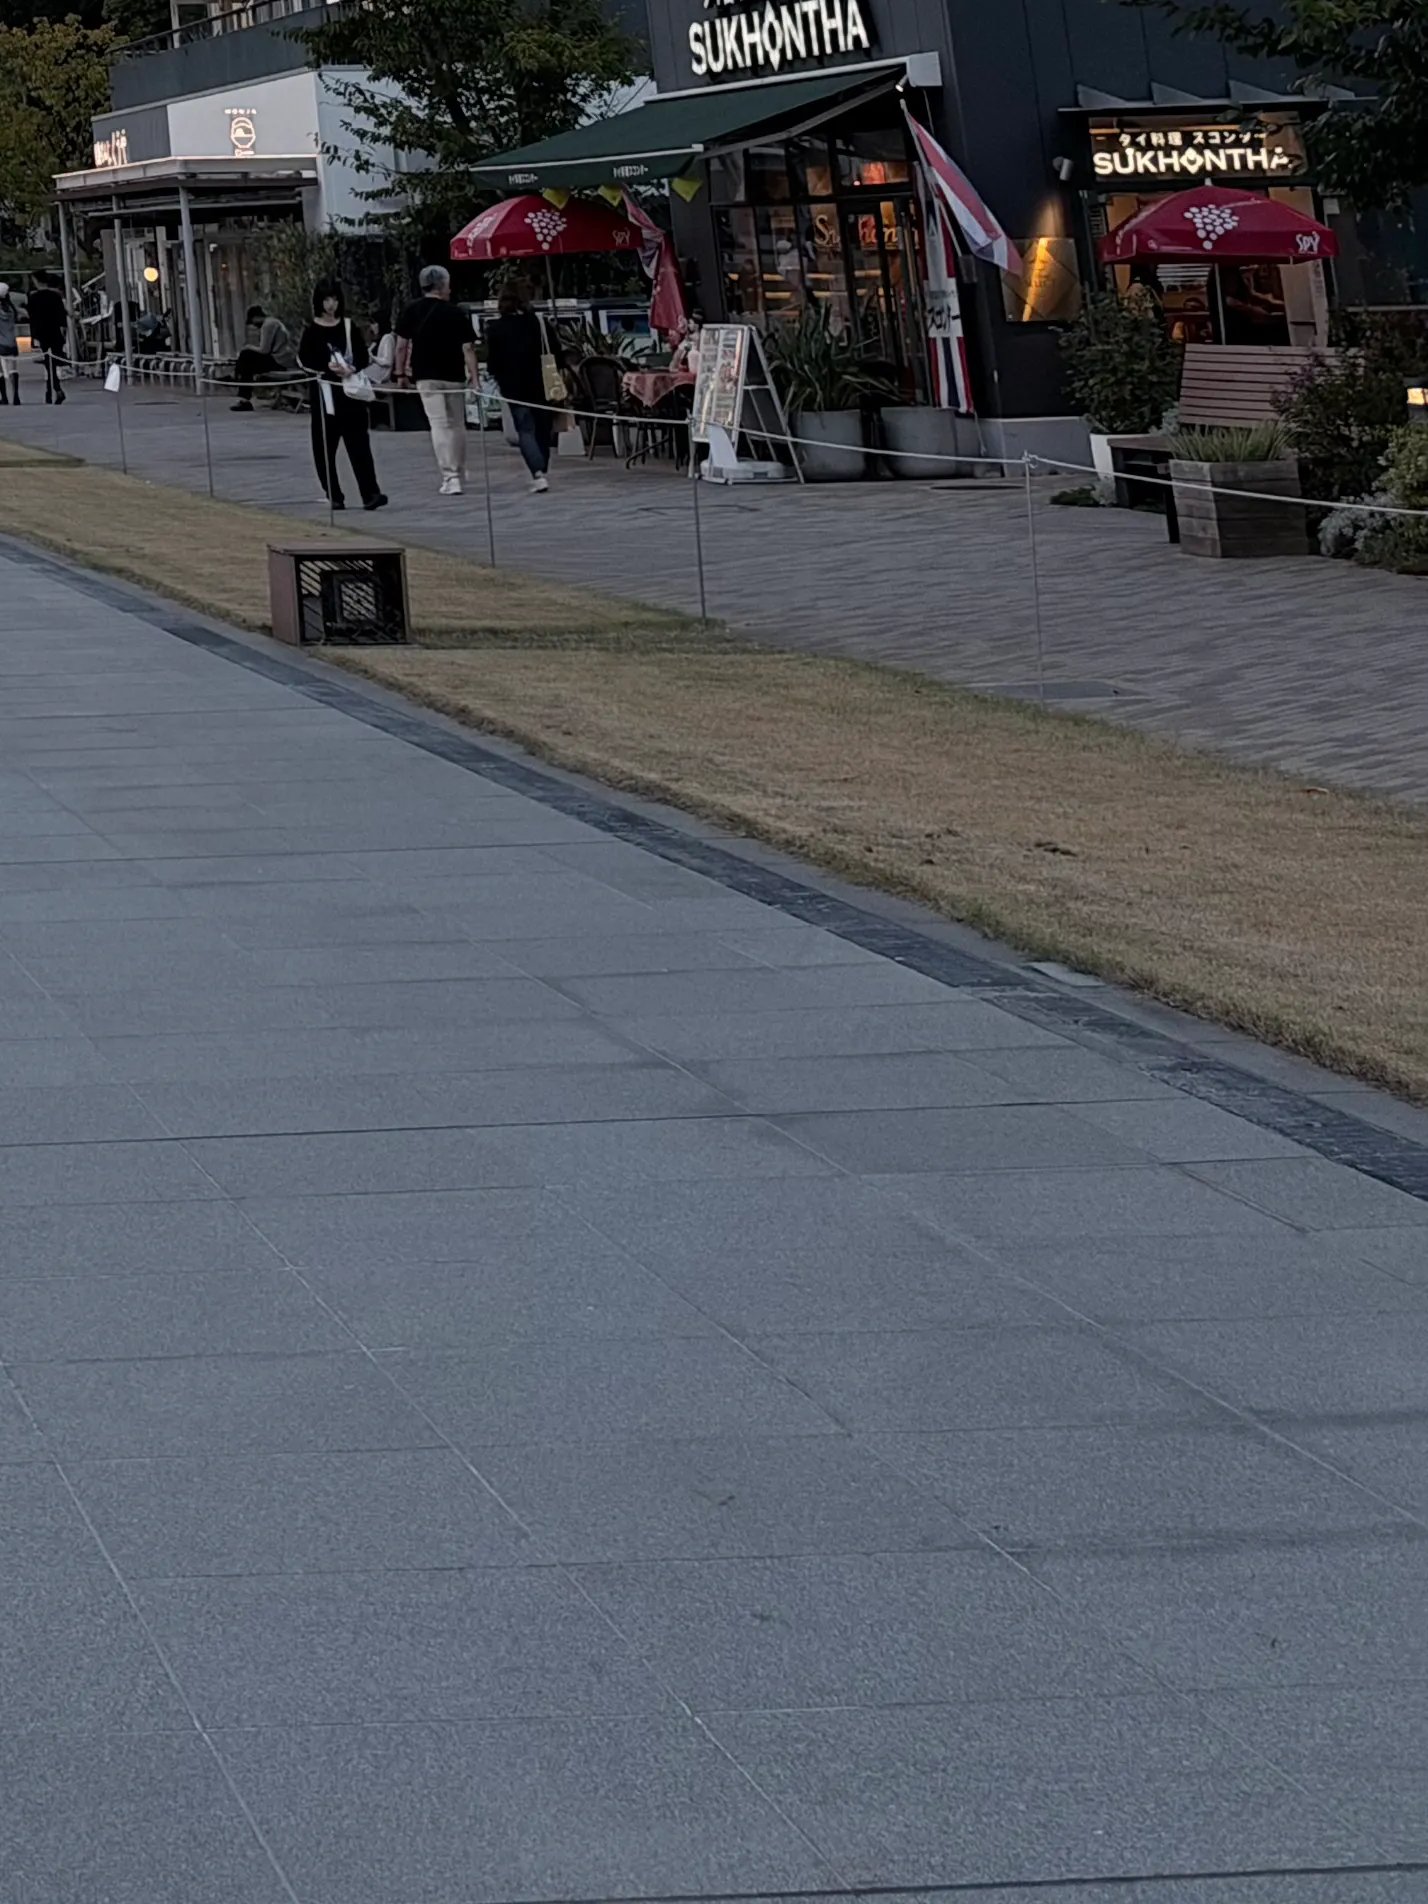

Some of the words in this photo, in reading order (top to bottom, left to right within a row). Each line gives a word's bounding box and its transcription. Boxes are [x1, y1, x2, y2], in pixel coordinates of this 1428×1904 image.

[1119, 131, 1183, 147] タイ料理
[1093, 146, 1294, 175] SUKHONTHA
